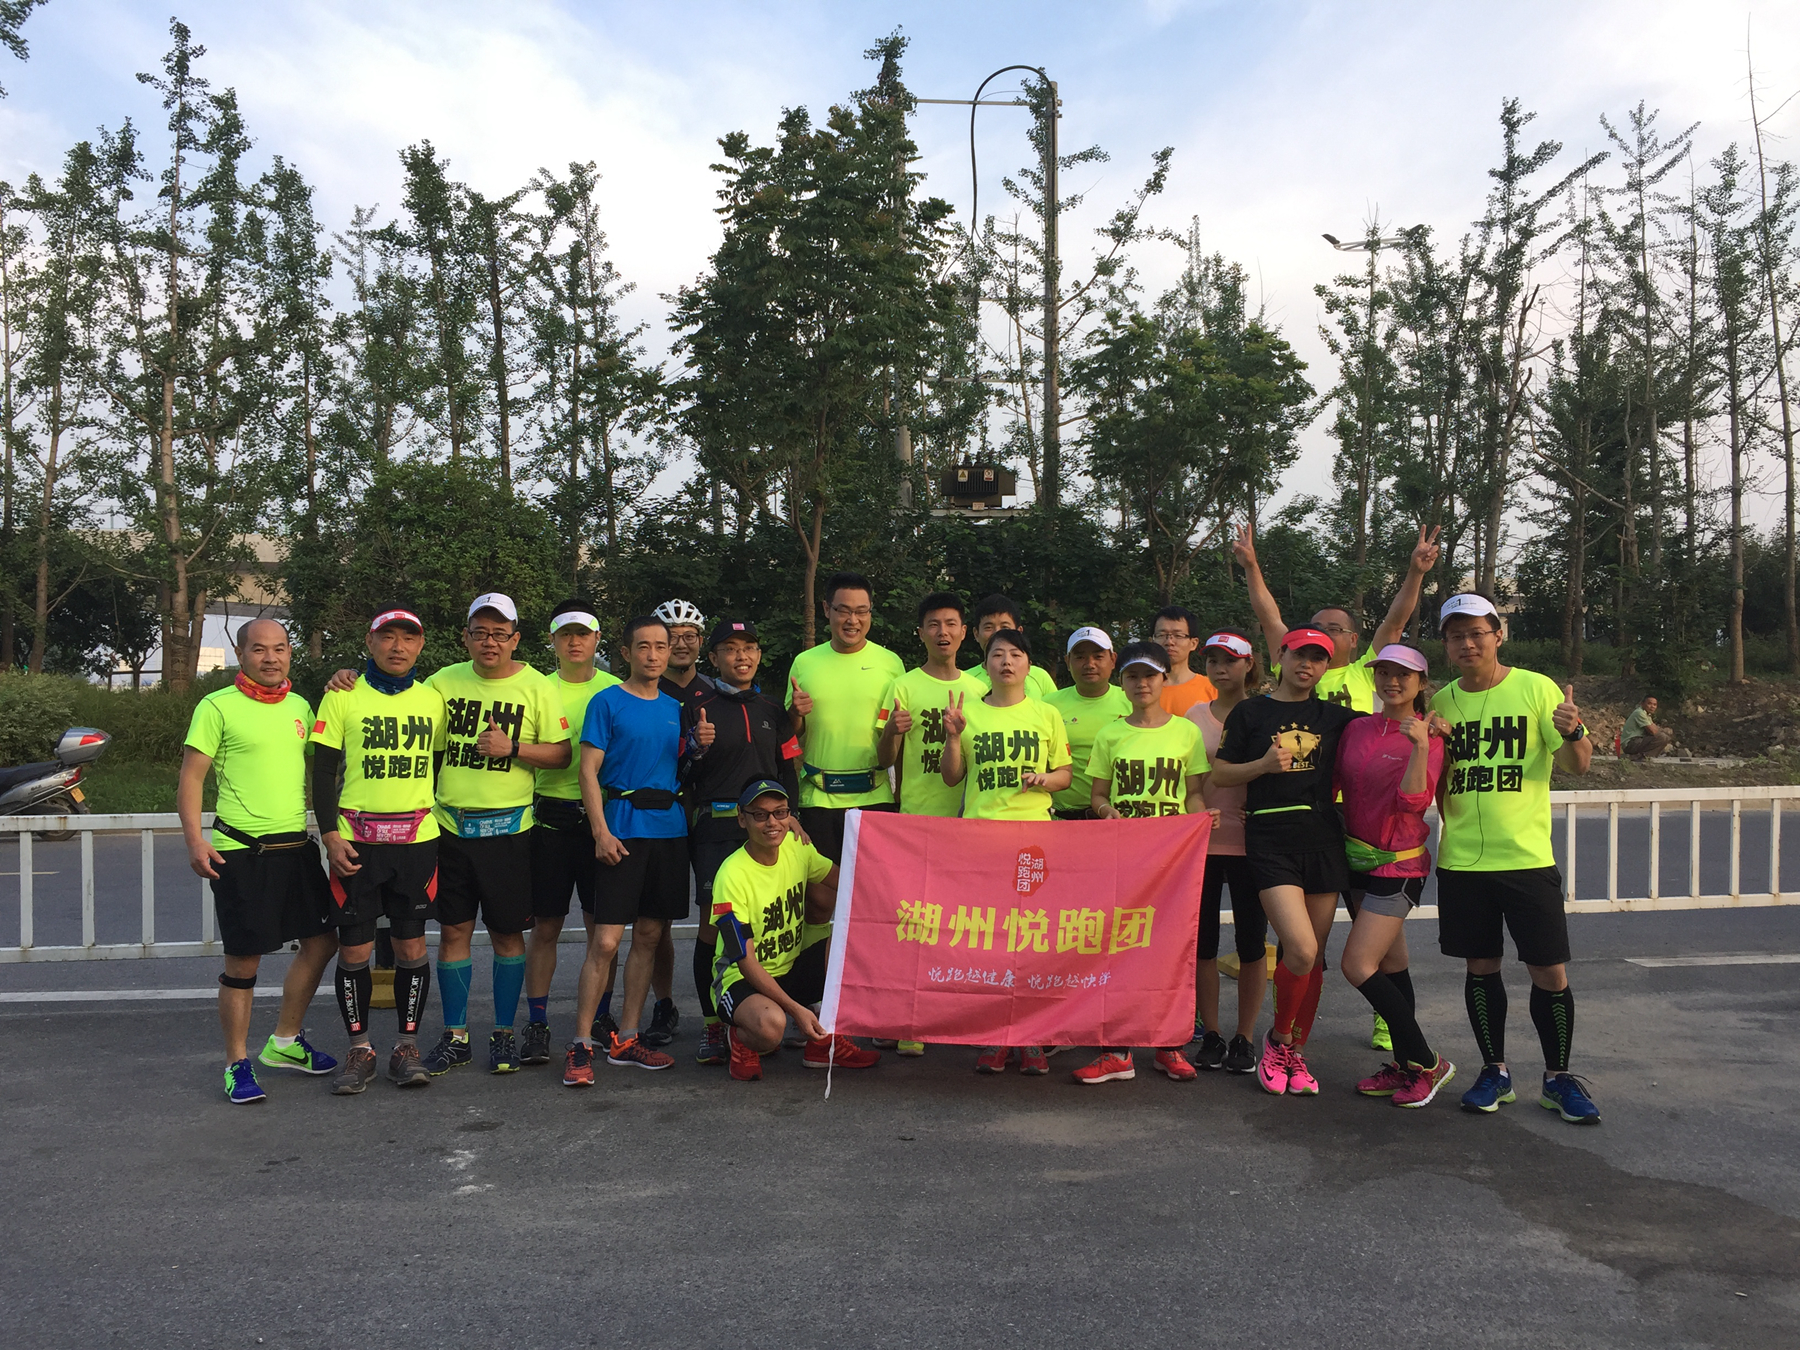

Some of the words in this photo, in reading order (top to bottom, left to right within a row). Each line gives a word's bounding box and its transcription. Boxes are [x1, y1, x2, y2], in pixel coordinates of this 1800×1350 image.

[361, 715, 432, 751] 湖州
[447, 697, 525, 740] 湖州
[973, 730, 1039, 765] 湖州
[1445, 715, 1527, 764] 湖州
[362, 755, 429, 779] 悦跑团
[1115, 757, 1182, 799] 湖州
[1449, 765, 1523, 795] 悦跑团
[1017, 853, 1031, 891] 悦跑团
[1031, 858, 1044, 882] 湖州
[762, 882, 803, 937] 湖州
[896, 900, 1156, 954] 湖州悦跑团
[928, 966, 1015, 988] 悦跑越健康
